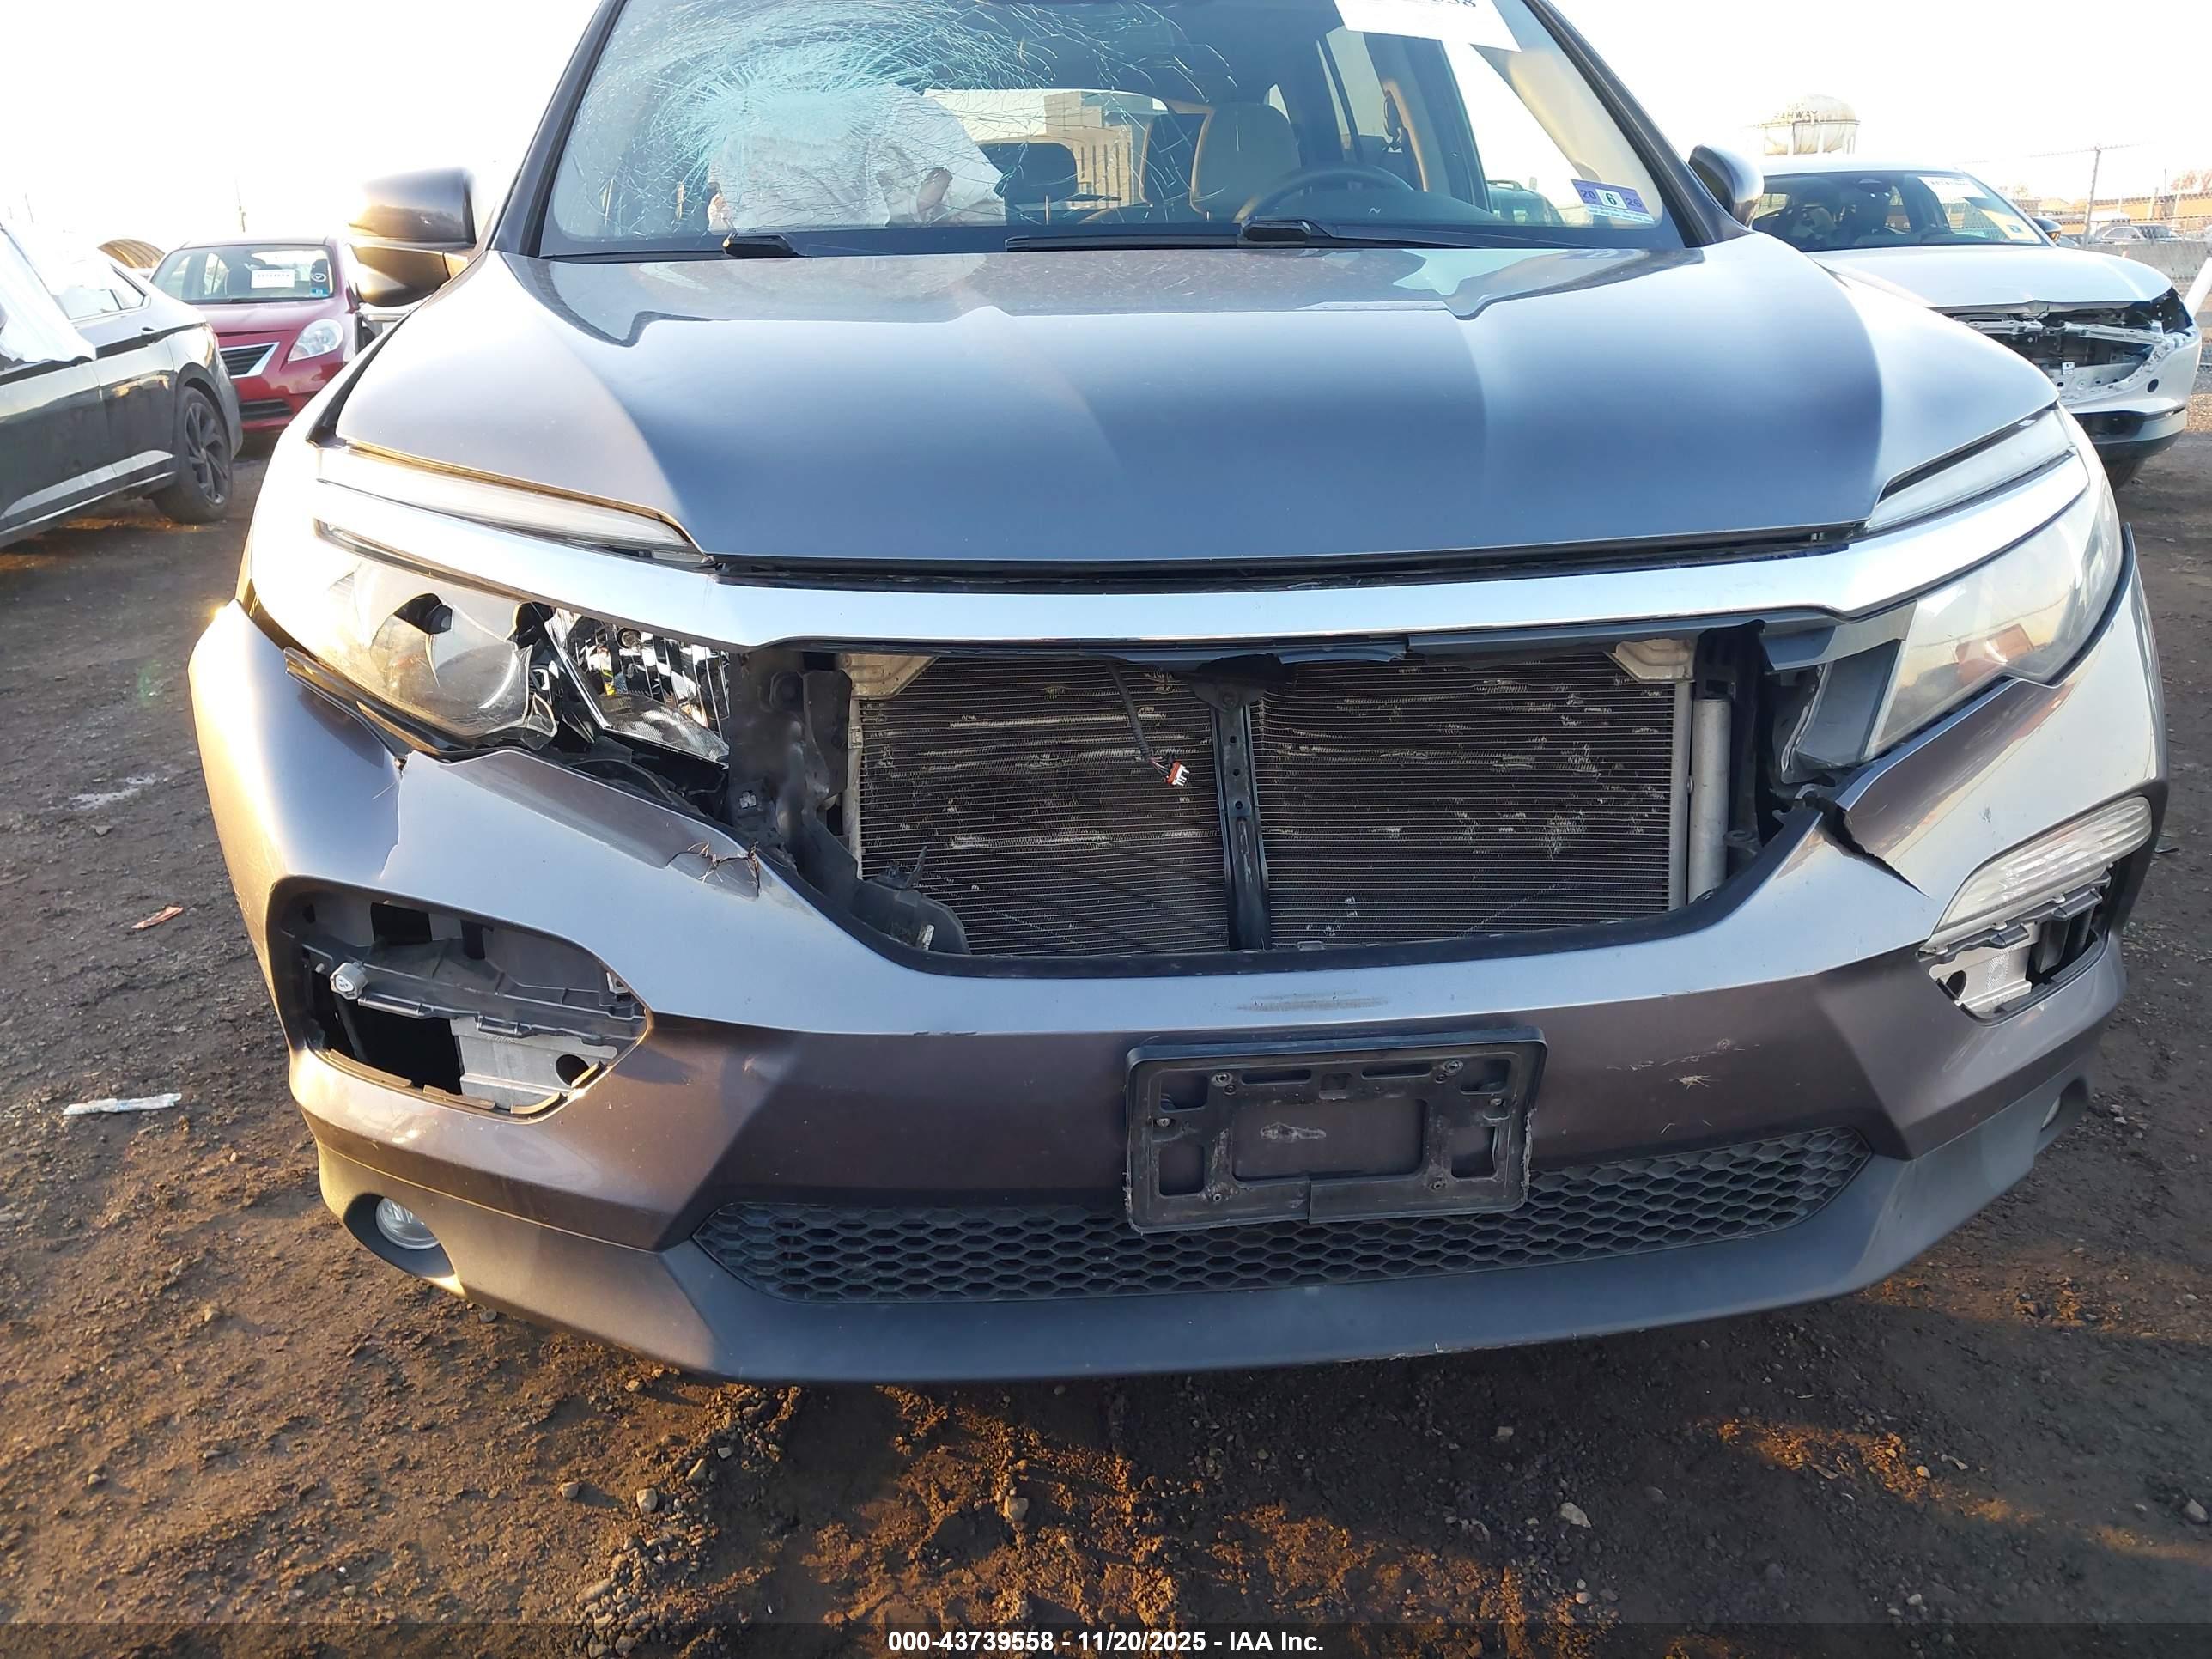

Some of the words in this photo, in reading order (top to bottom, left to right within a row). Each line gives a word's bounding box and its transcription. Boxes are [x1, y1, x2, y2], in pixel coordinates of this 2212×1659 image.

[1580, 190, 1597, 200] 20
[1605, 192, 1618, 206] 6
[1625, 198, 1643, 208] 26
